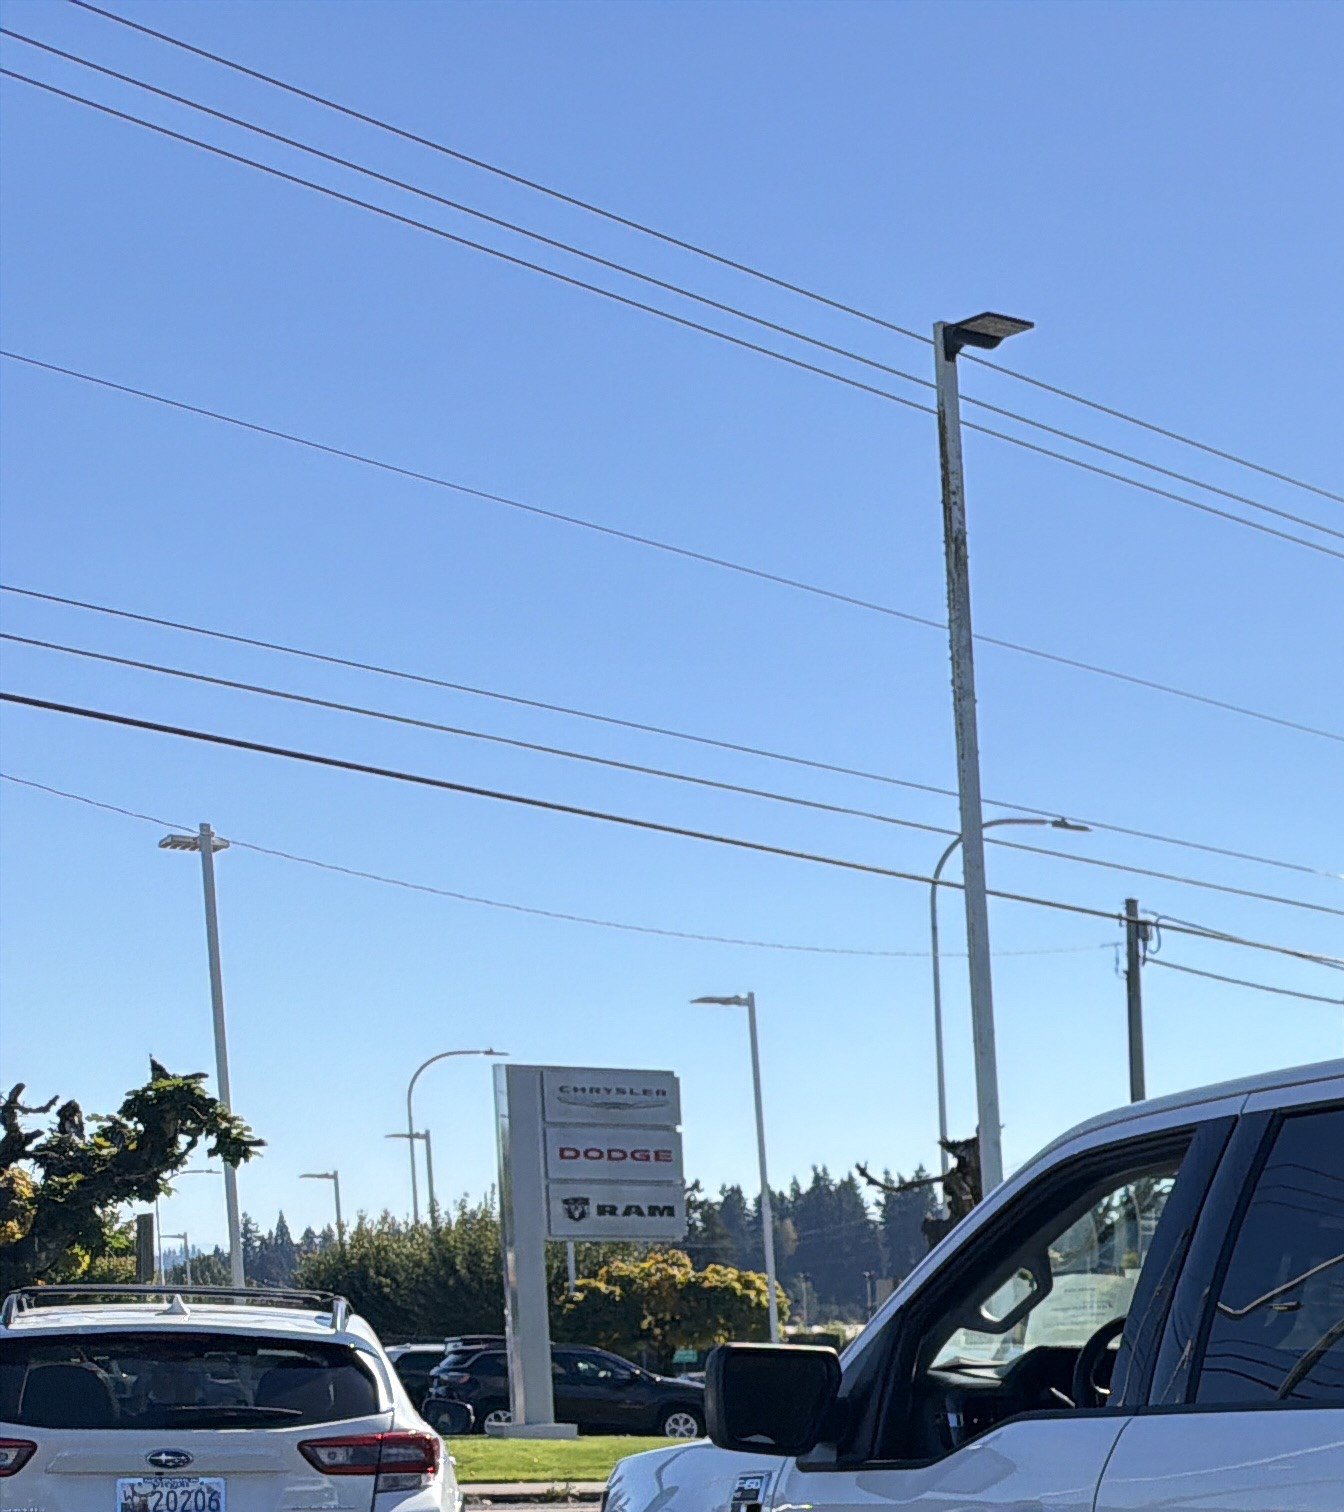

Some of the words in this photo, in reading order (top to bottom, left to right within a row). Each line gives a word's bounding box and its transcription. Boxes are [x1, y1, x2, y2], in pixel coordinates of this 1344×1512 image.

[559, 1085, 667, 1097] CHRYSLER
[559, 1147, 673, 1163] DODGE
[596, 1203, 675, 1218] RAM
